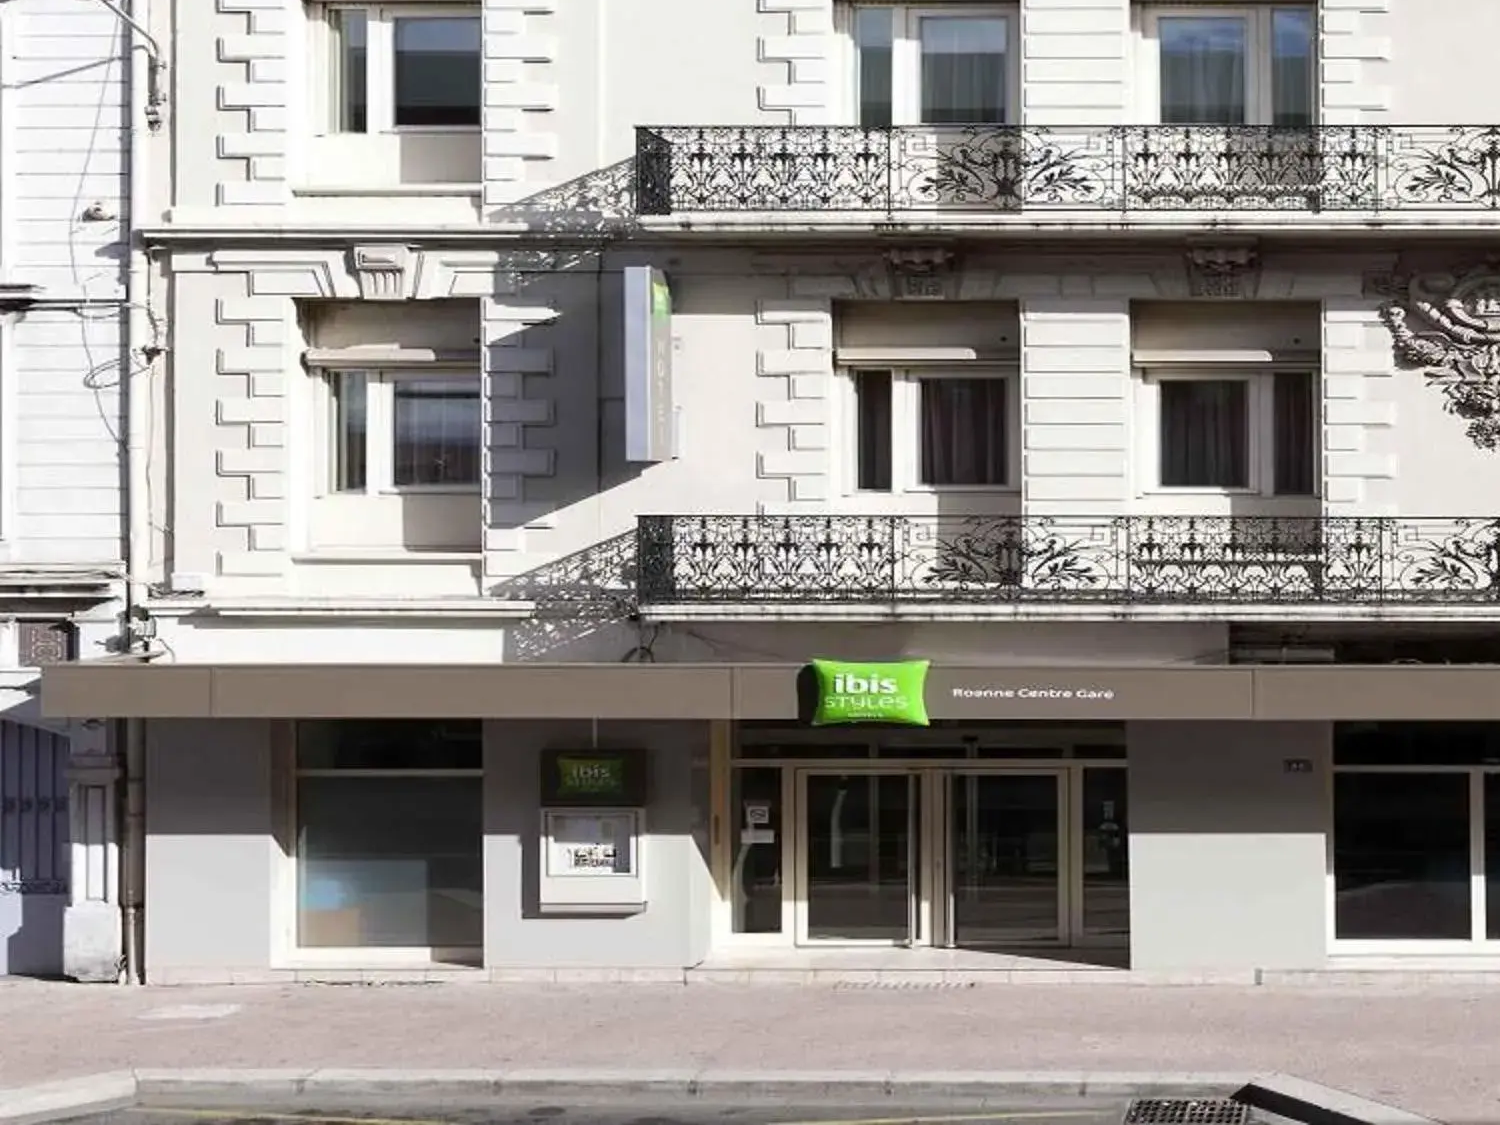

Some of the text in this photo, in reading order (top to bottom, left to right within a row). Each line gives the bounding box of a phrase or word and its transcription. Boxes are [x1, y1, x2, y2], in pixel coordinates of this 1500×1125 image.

[834, 674, 898, 694] ibis
[952, 687, 1115, 699] Roanne Centre Gare
